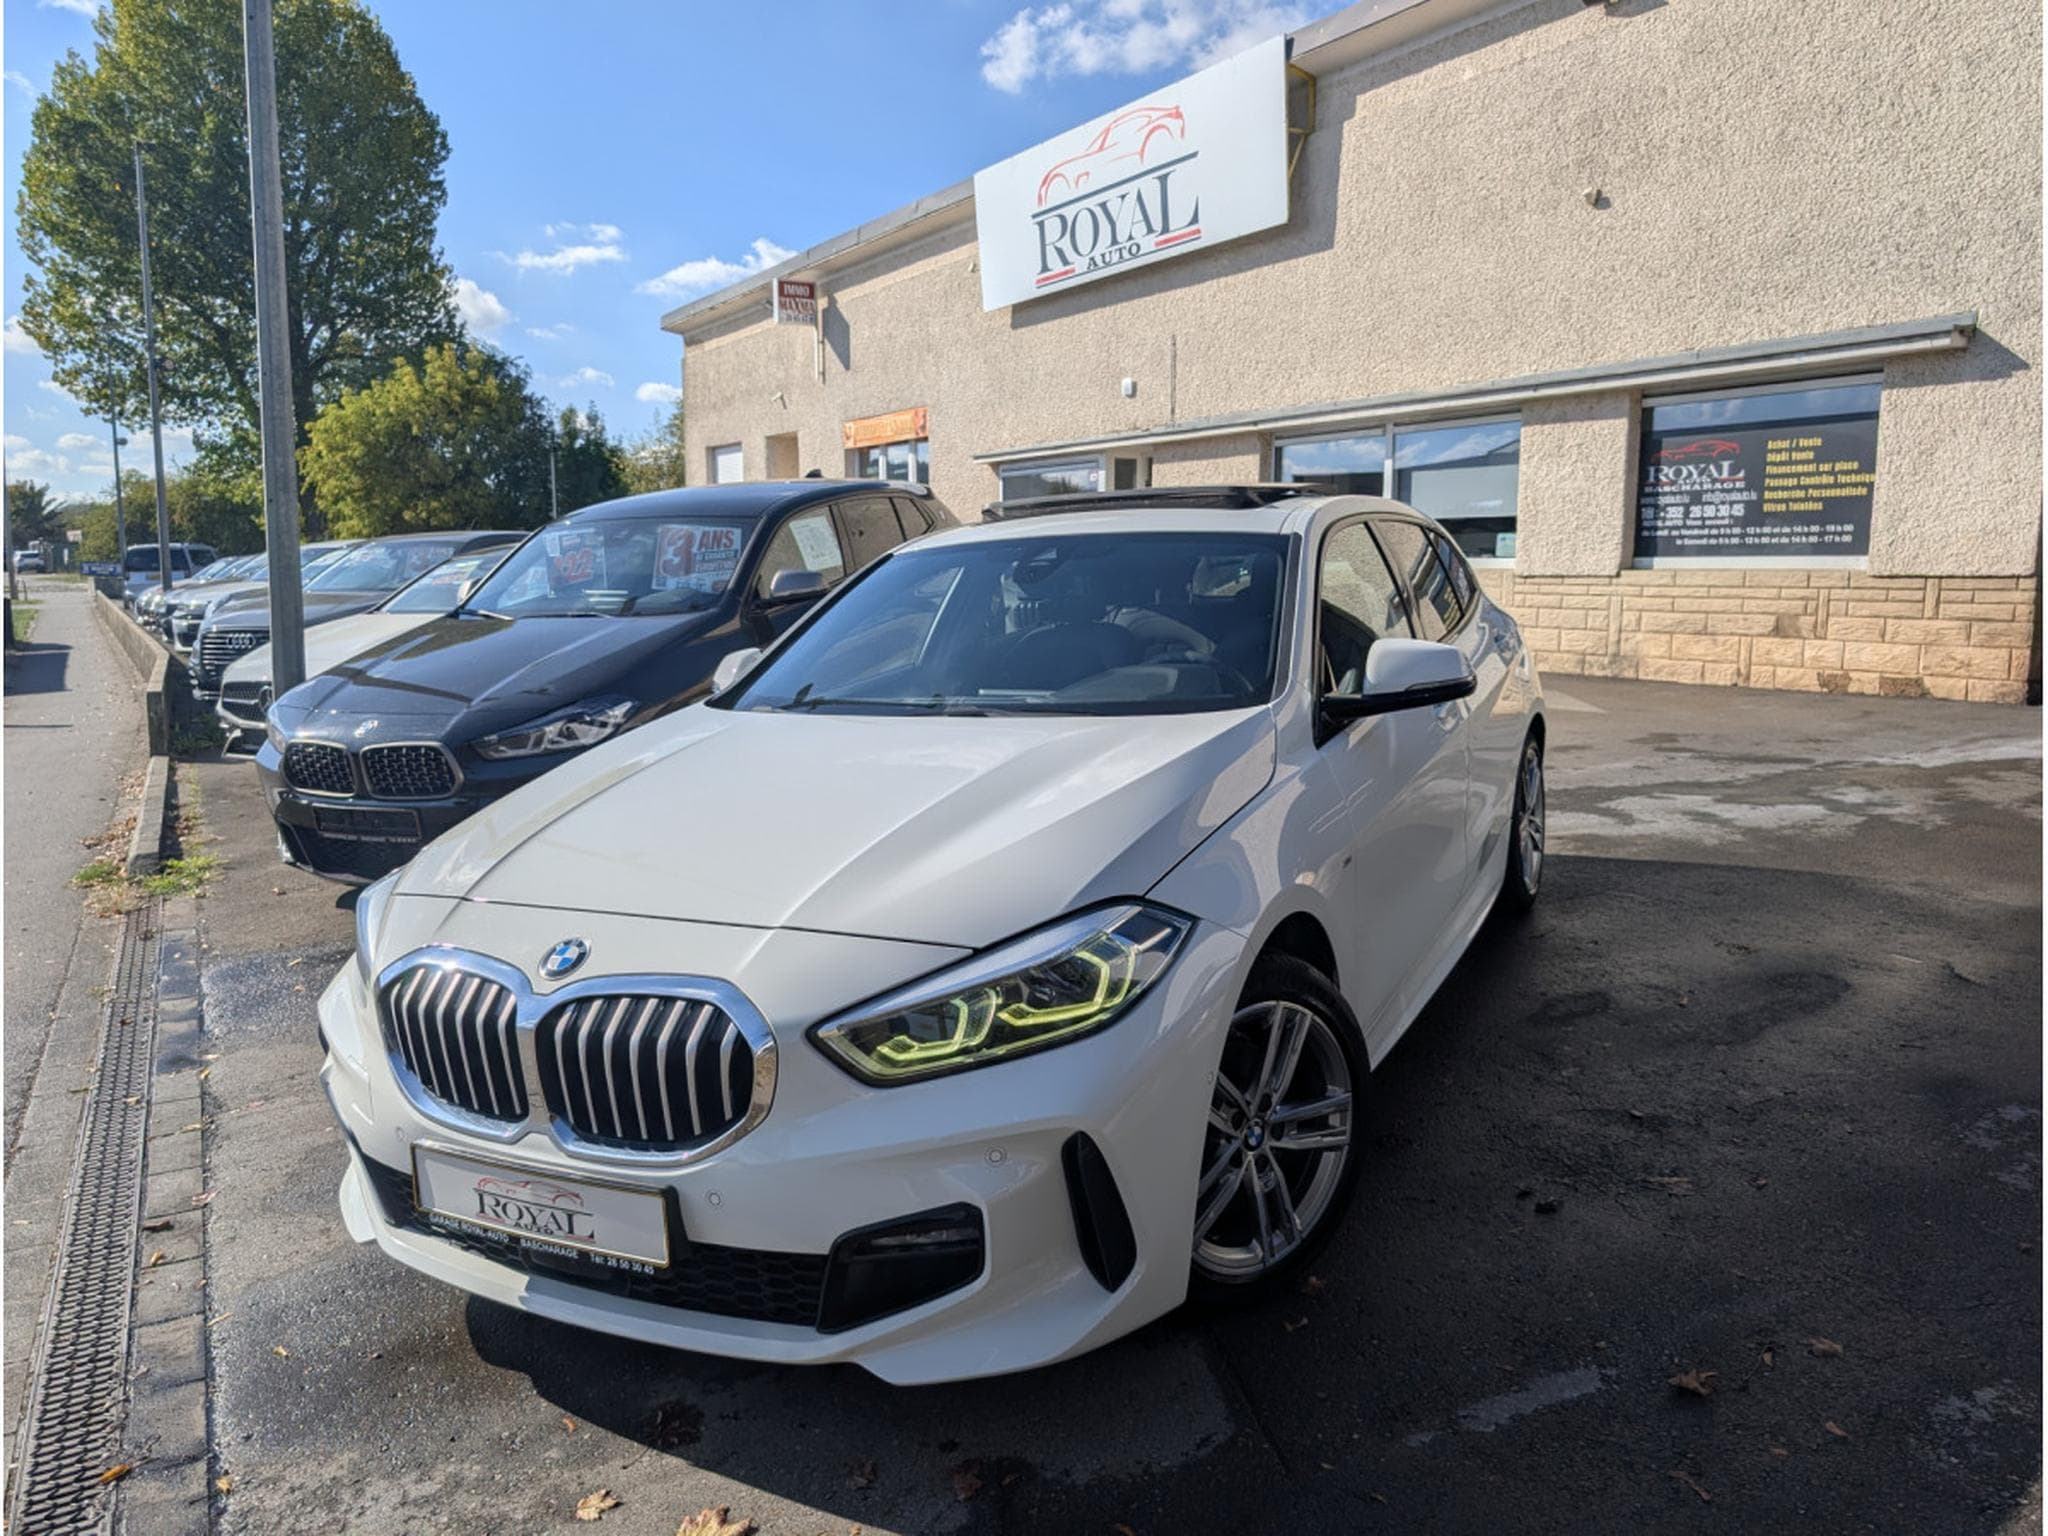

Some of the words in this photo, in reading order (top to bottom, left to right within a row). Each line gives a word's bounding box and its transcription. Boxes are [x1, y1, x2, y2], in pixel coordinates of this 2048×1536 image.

[1035, 169, 1199, 275] ROYAL
[1086, 242, 1141, 270] AUTO
[1646, 460, 1745, 482] ROYAL
[700, 529, 734, 549] ANS
[478, 1193, 595, 1238] ROYAL
[520, 1238, 578, 1259] BASCHARAGE
